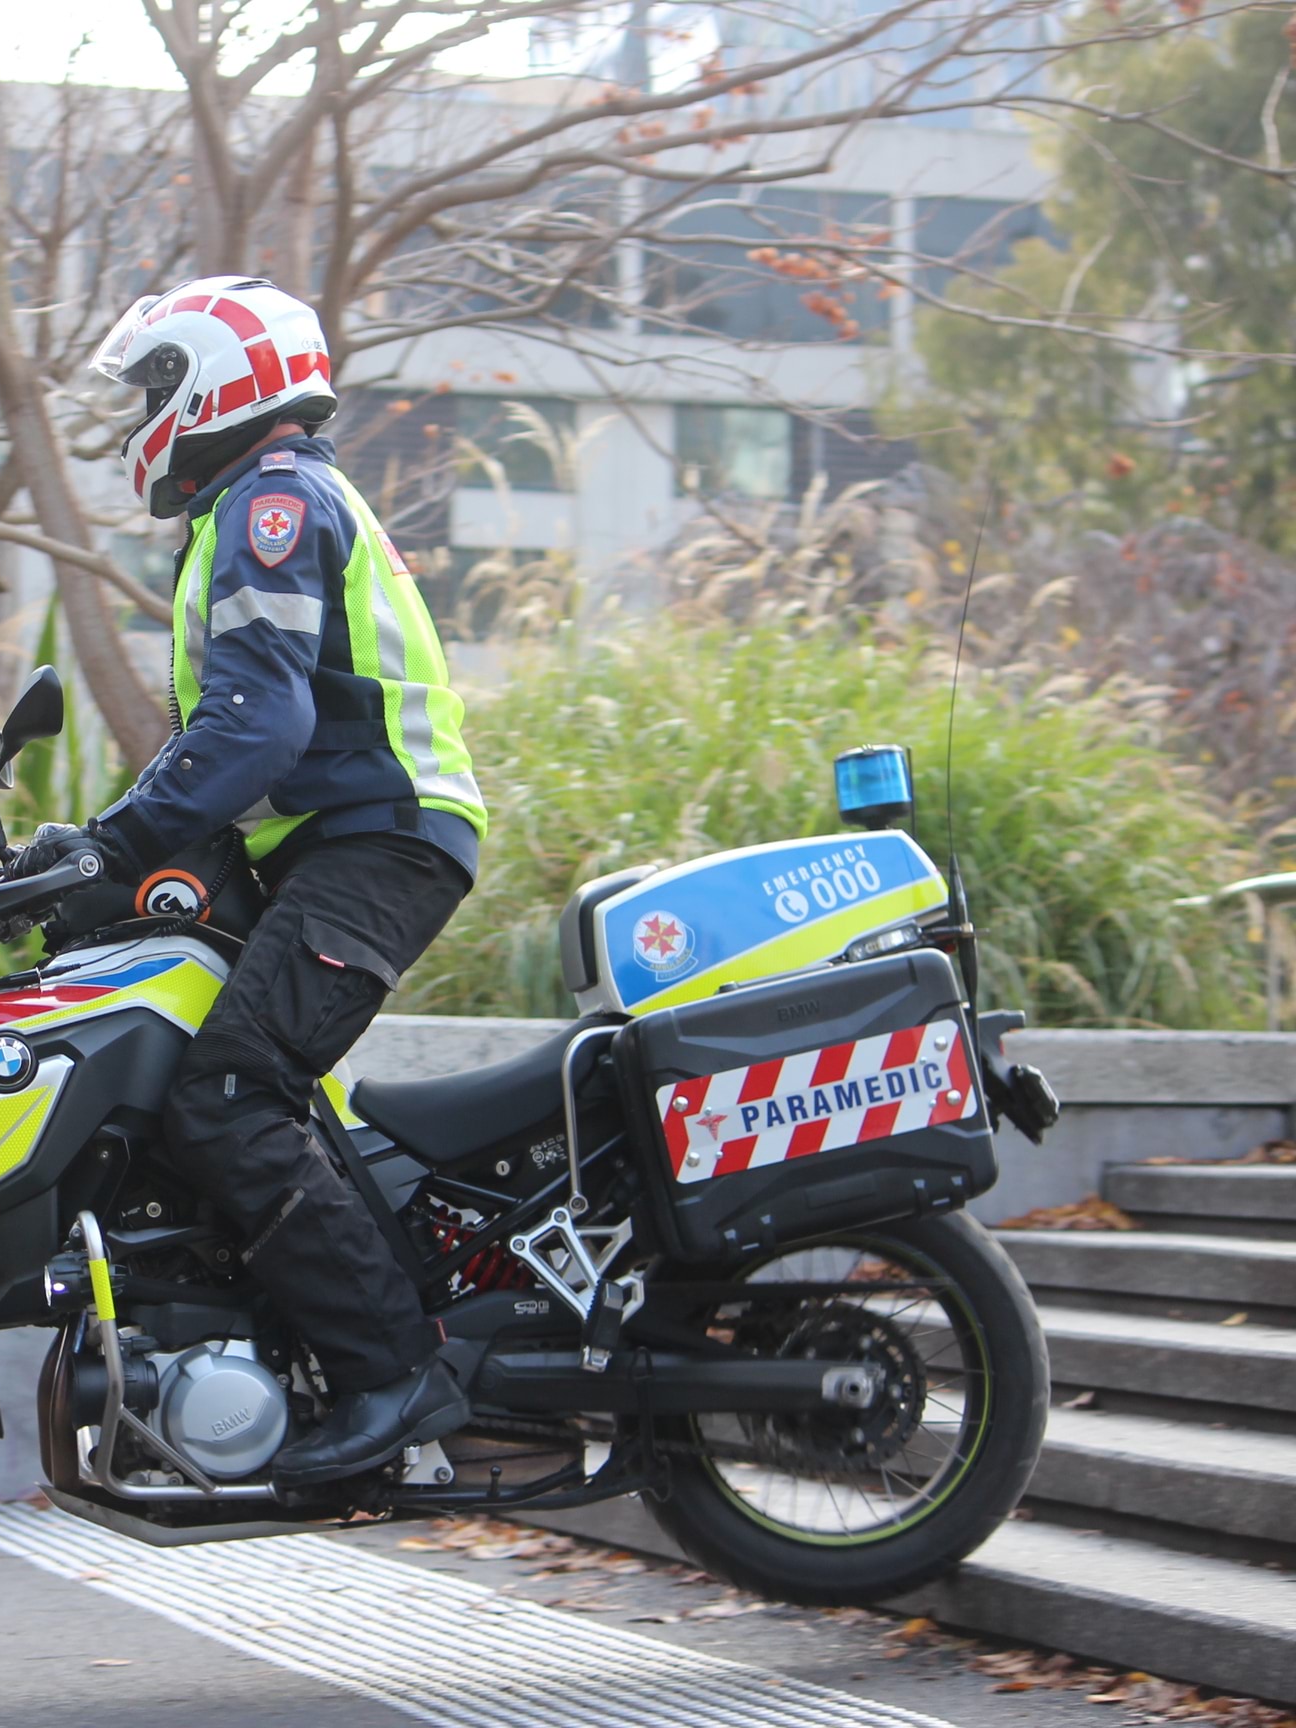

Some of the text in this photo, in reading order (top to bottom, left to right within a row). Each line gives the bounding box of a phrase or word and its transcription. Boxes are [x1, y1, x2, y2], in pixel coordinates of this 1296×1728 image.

[254, 497, 302, 511] PARAMEDIC
[762, 843, 866, 896] EMERGENCY
[810, 859, 881, 910] 000
[777, 1000, 821, 1022] BMW
[740, 1061, 943, 1133] PARAMEDIC
[211, 1407, 251, 1437] BMW
